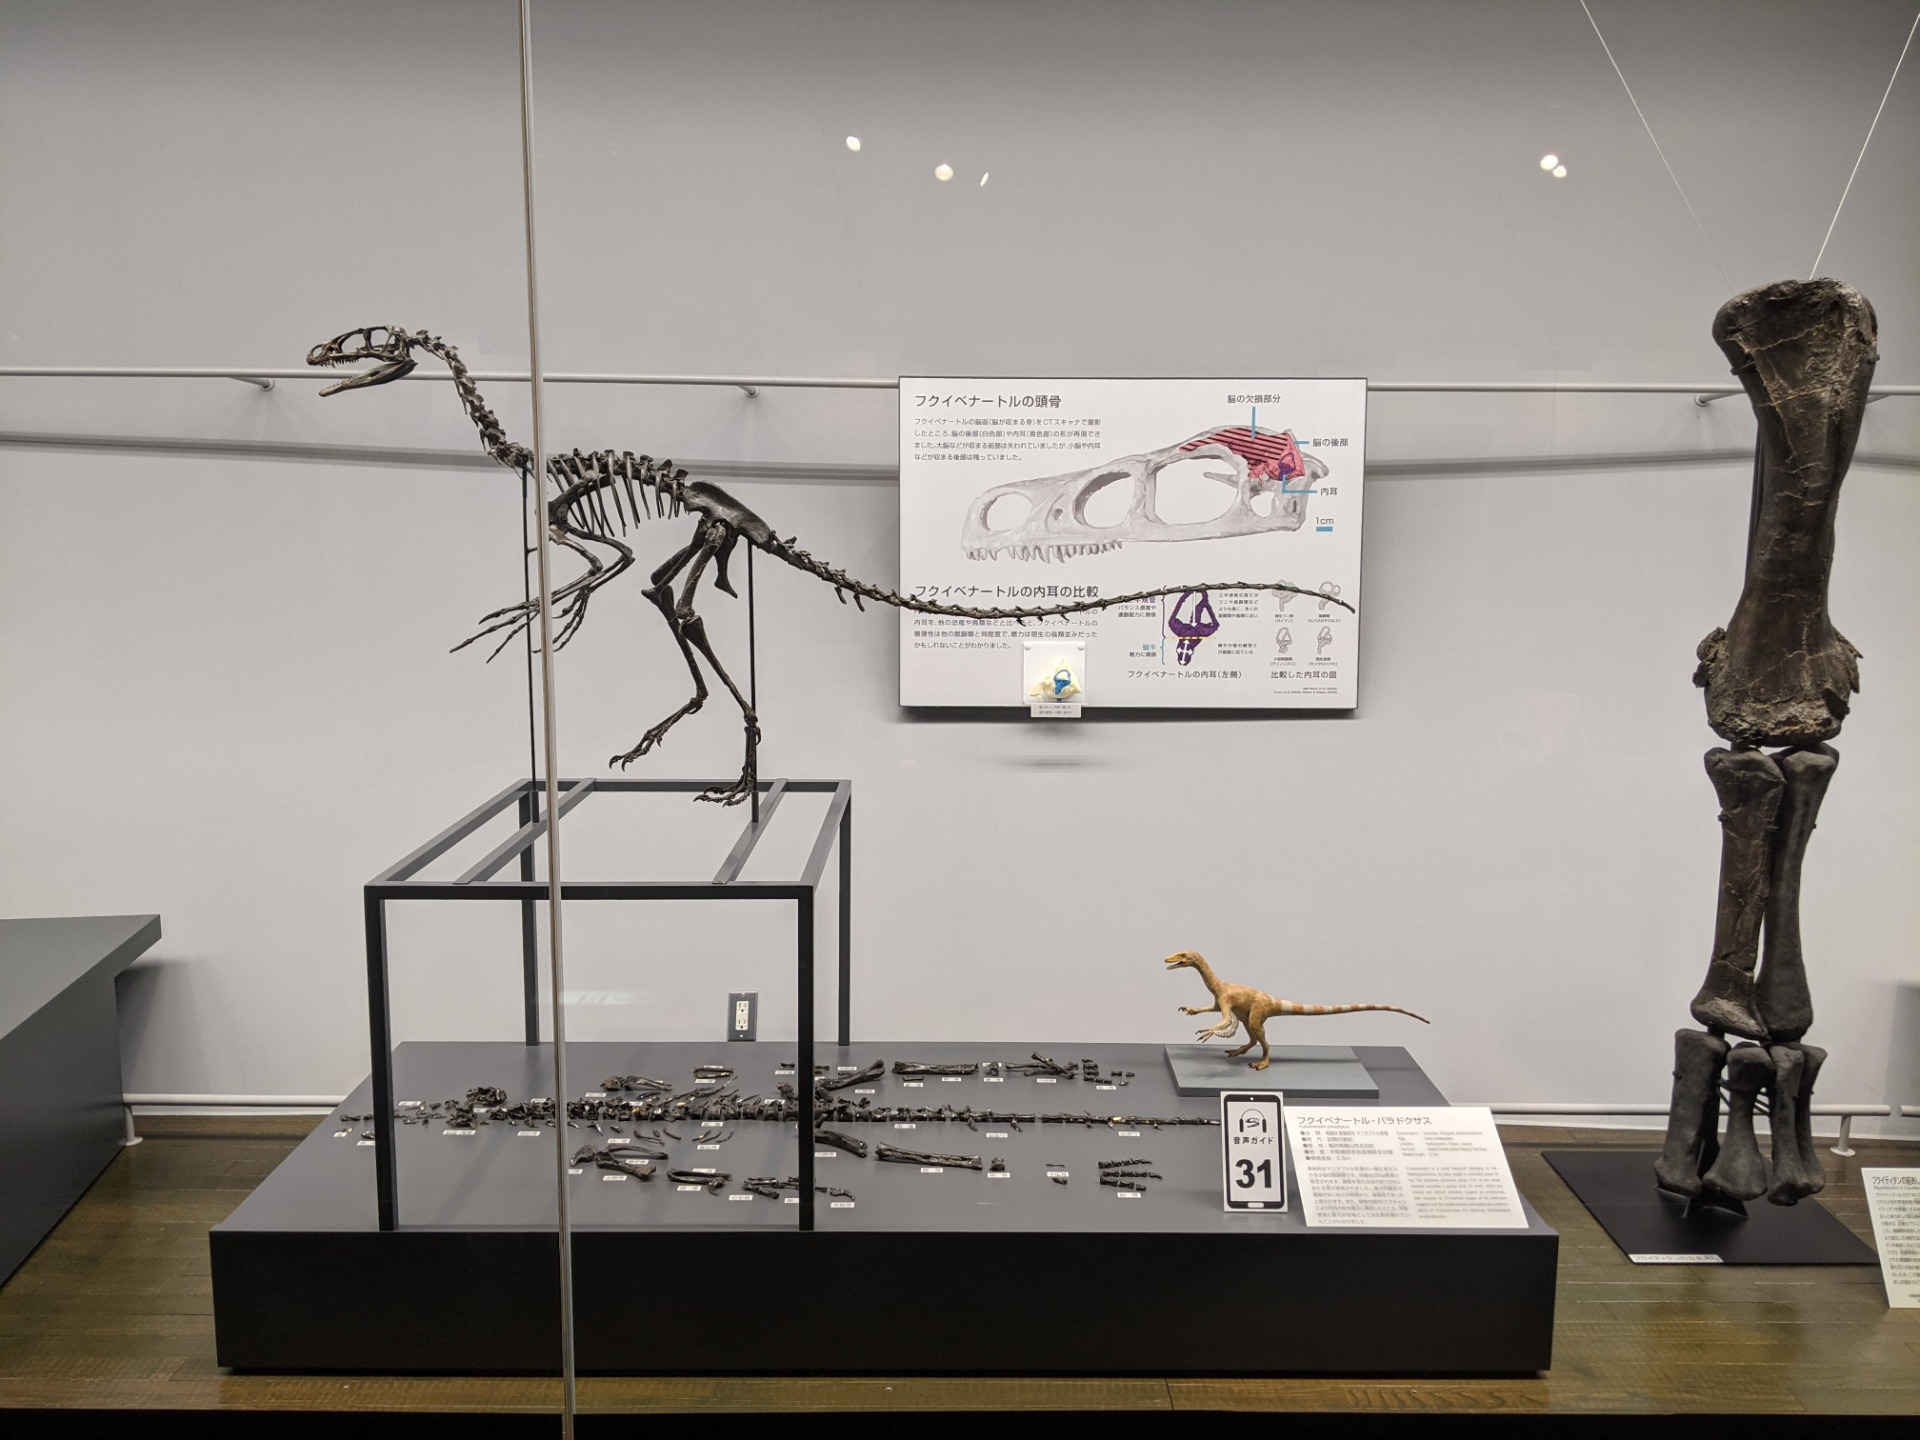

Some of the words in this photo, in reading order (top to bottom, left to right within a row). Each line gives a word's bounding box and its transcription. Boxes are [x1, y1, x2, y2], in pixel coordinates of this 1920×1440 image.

[914, 394, 1062, 409] フクイベナートルの頭骨
[1227, 394, 1281, 404] 脳の欠損部分
[1312, 437, 1349, 447] 脳の後部
[1320, 487, 1338, 496] 内耳
[1315, 517, 1334, 525] 1cm
[915, 585, 1099, 598] フクイベナートルの内耳の比較
[1271, 671, 1337, 679] 比較した内耳の図
[1297, 1116, 1432, 1125] フクイベナートル・パラドクサス
[1233, 1136, 1274, 1145] 音声ガイド
[1235, 1158, 1272, 1189] 31
